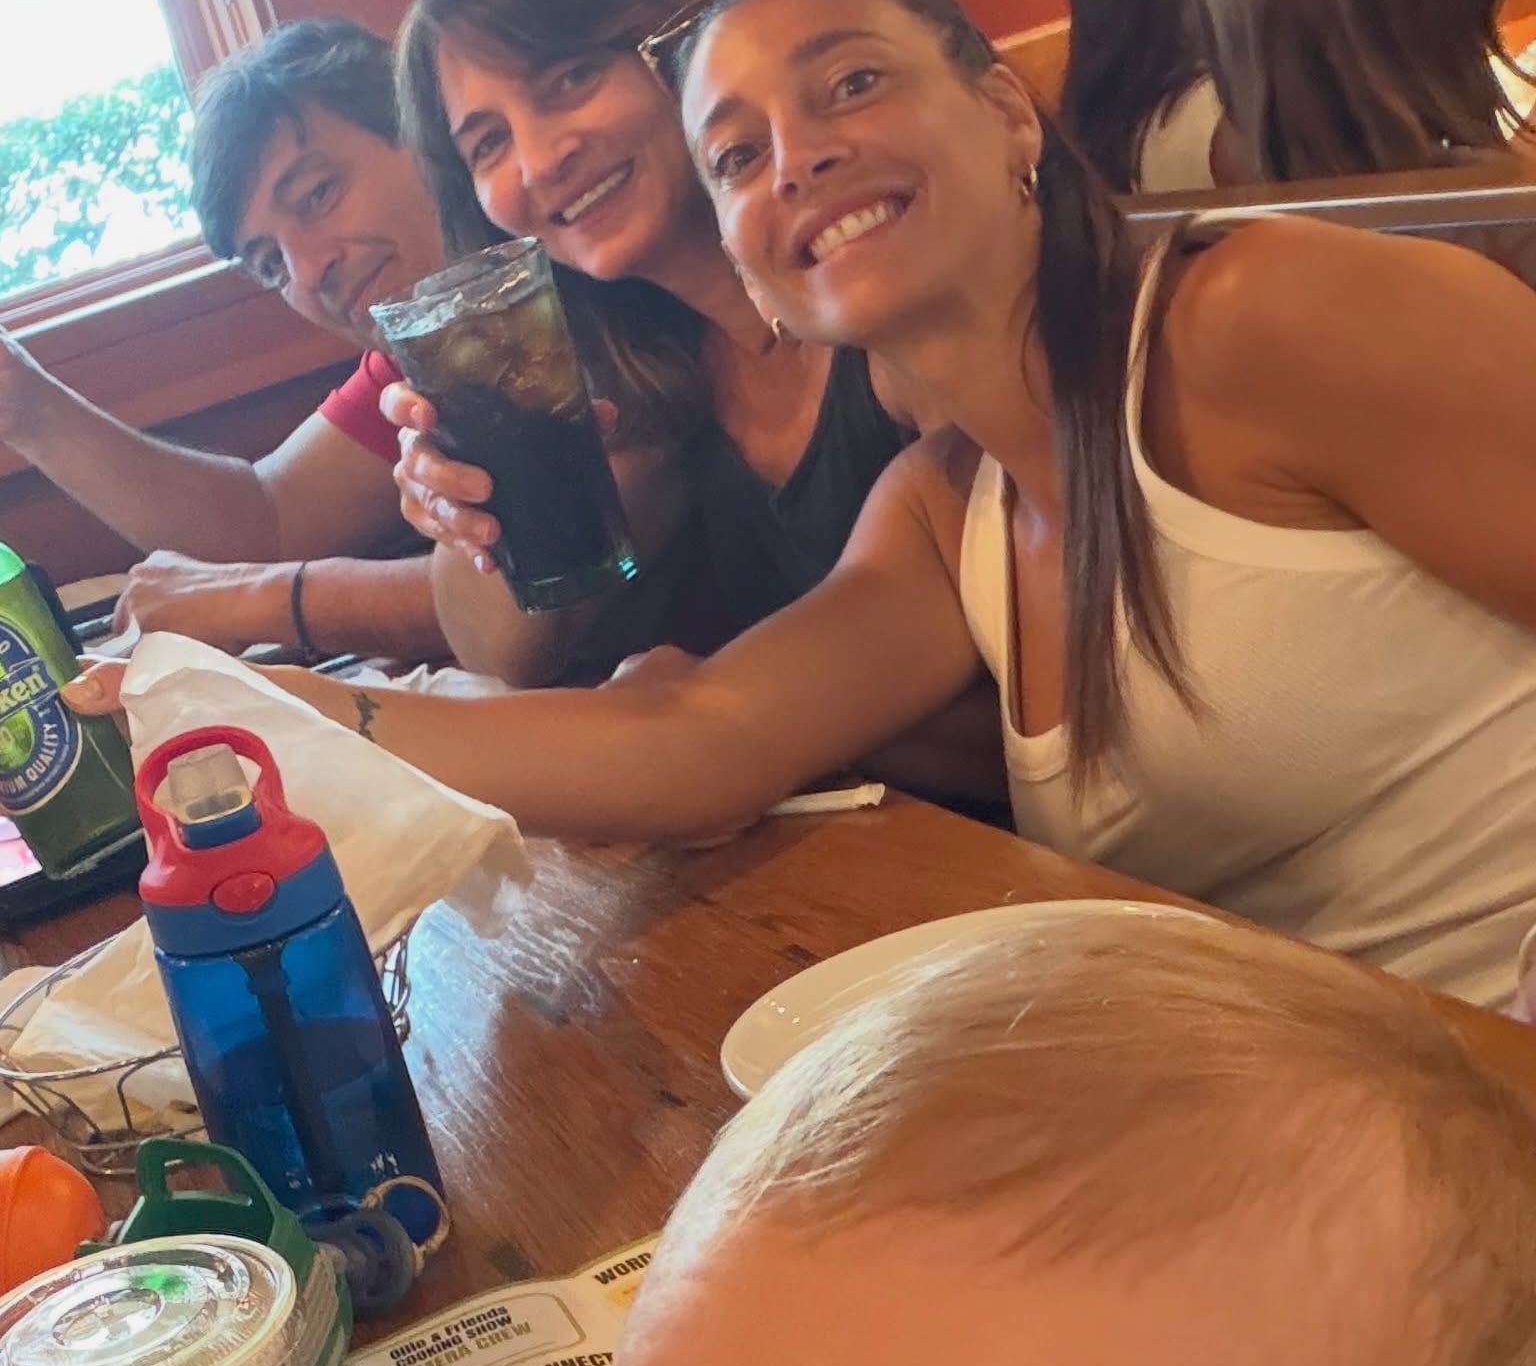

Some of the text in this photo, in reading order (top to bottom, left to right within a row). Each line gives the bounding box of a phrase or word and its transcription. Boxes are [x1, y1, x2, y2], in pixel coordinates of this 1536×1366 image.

[25, 722, 59, 782] QUALITY
[444, 1306, 510, 1336] Friends
[466, 1314, 513, 1340] SHOW
[476, 1322, 532, 1351] CREW
